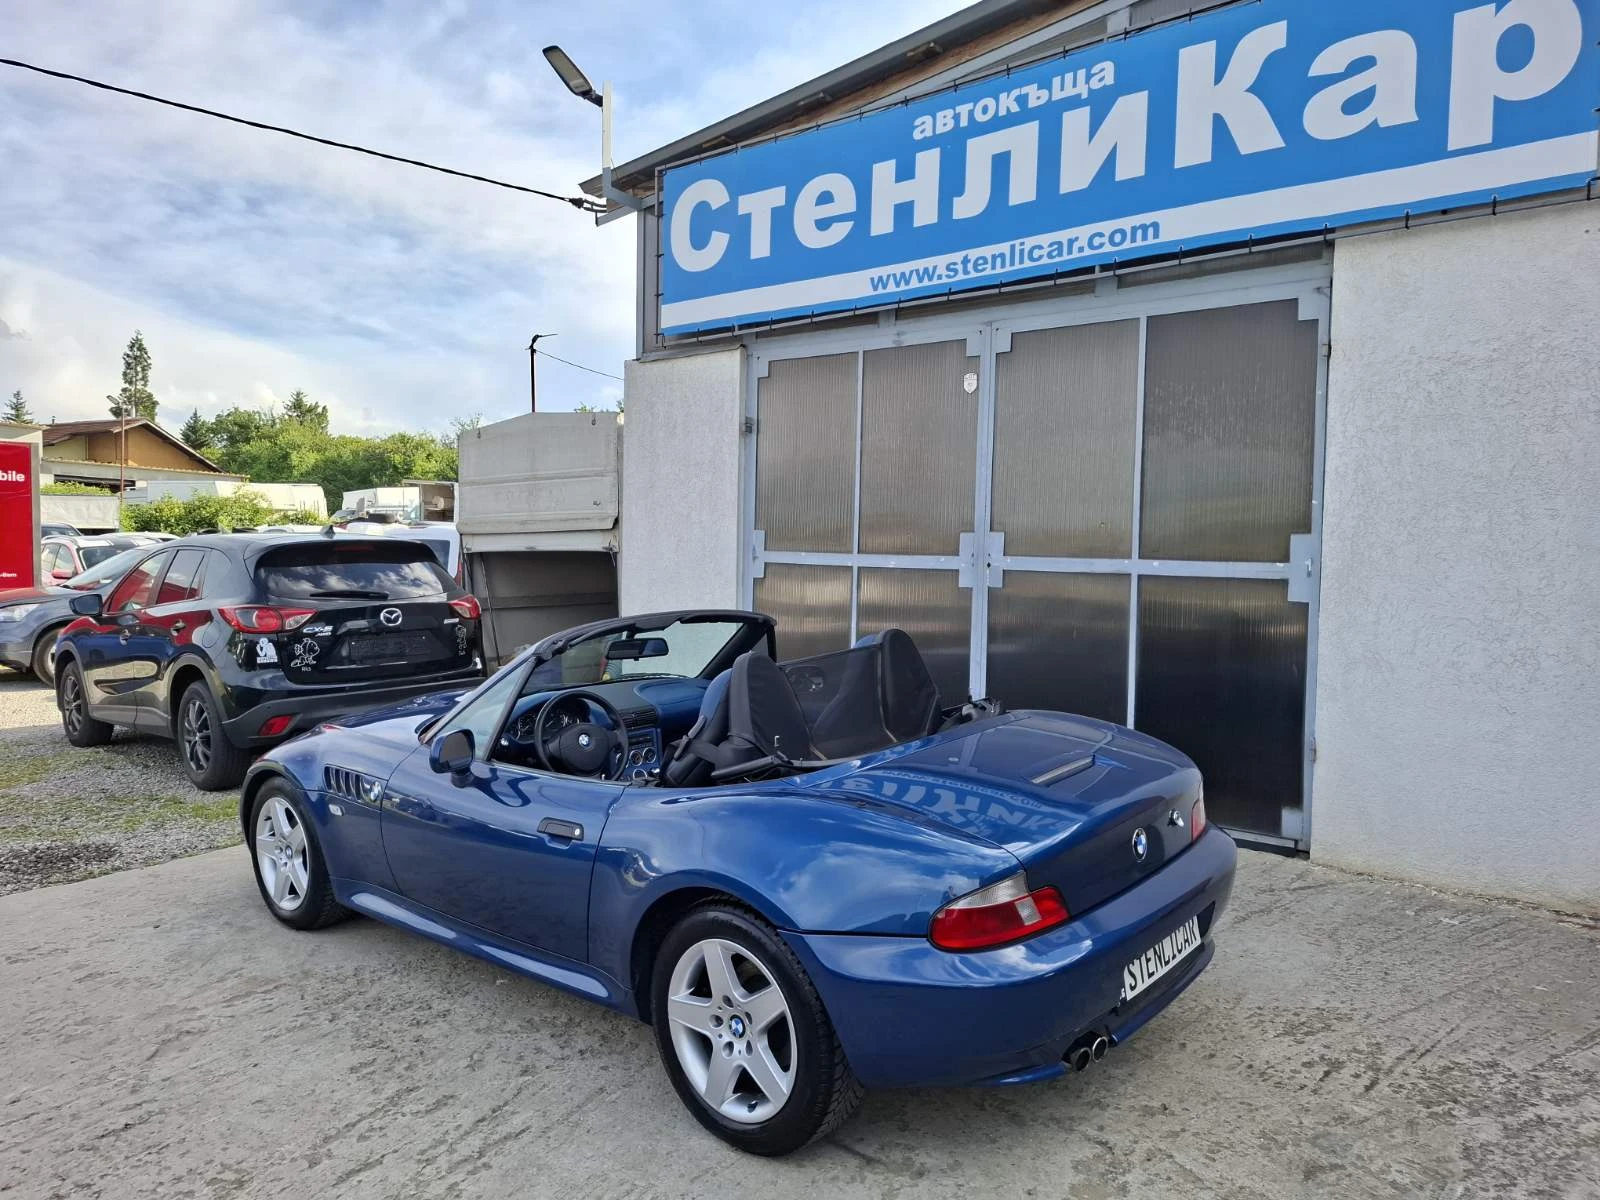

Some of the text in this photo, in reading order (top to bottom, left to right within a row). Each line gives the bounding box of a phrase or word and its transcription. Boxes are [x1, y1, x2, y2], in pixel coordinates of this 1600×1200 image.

[912, 60, 1115, 140] автокъща
[870, 221, 1160, 292] www.stenlicar.com
[1127, 916, 1197, 992] STENLICAR
